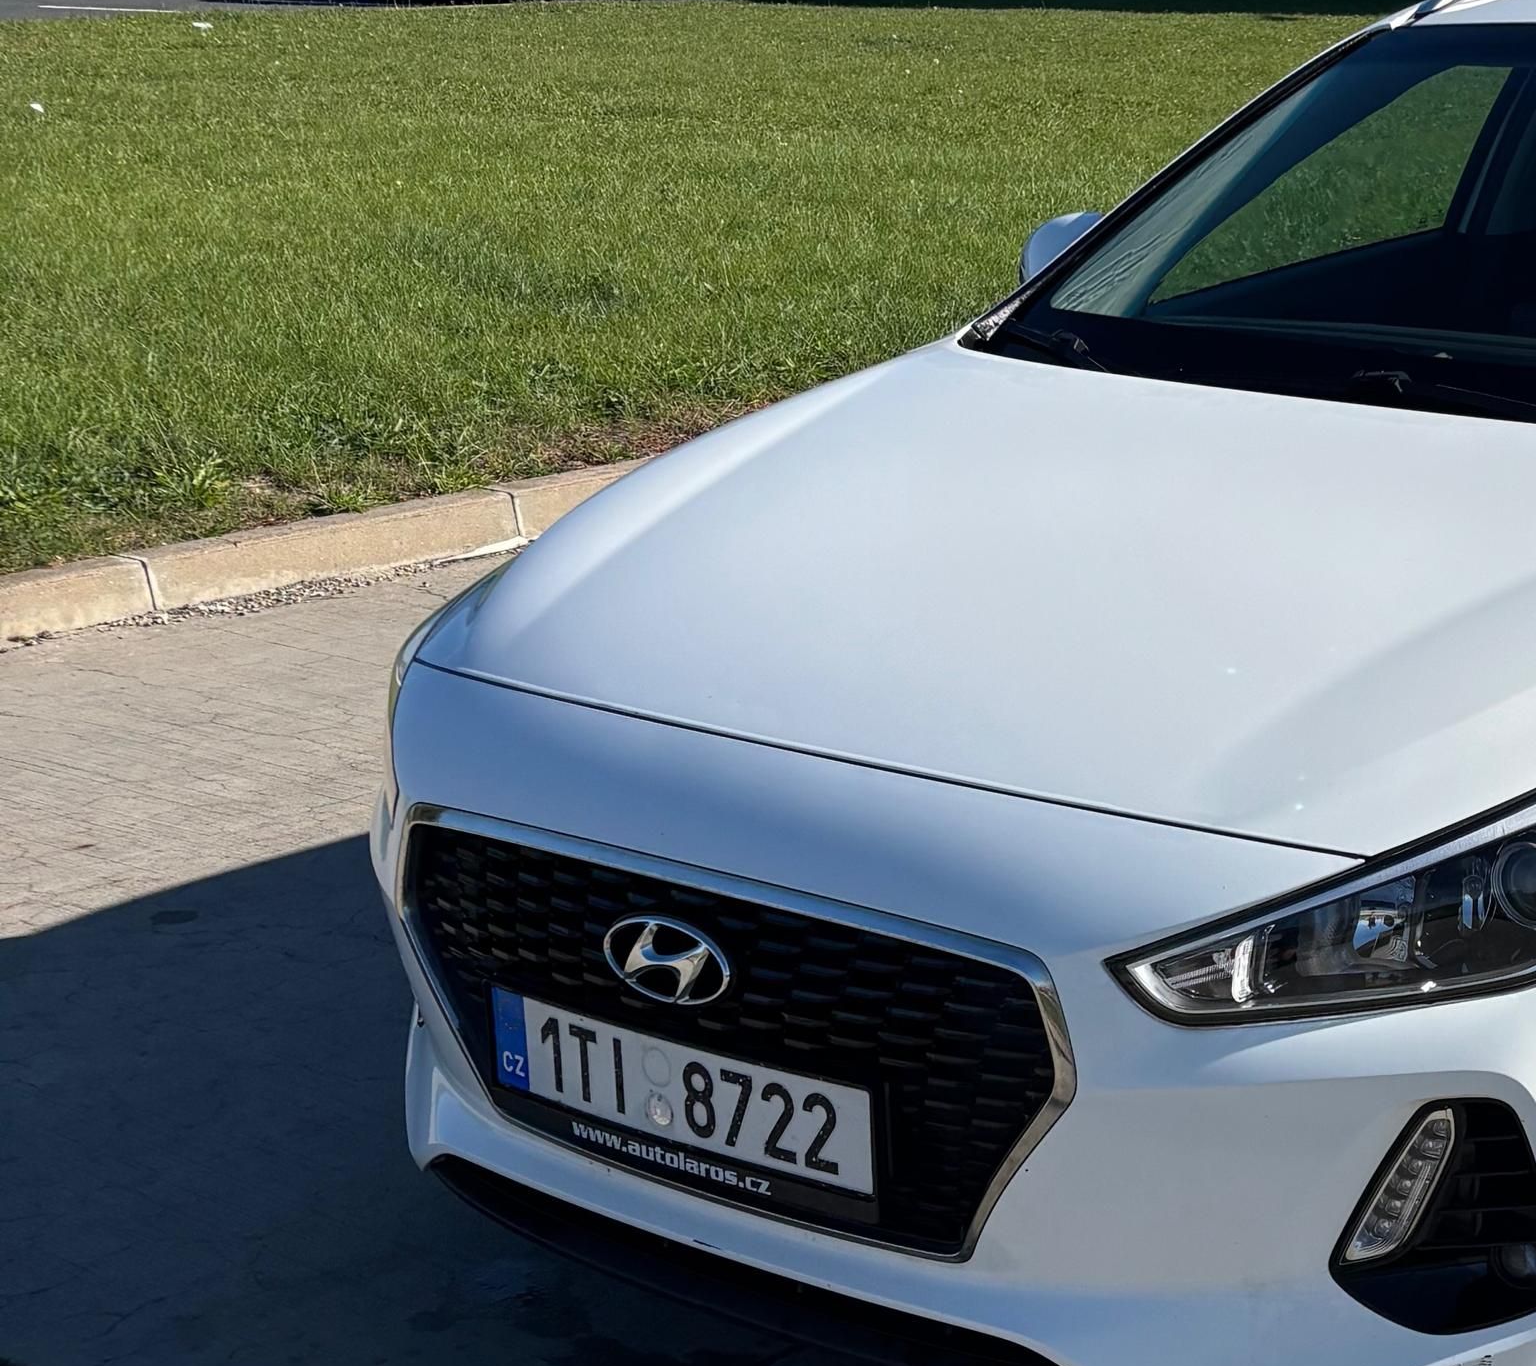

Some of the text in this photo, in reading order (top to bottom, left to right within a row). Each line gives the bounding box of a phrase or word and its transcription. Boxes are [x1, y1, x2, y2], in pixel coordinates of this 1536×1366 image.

[503, 1051, 526, 1077] CZ
[541, 1017, 839, 1176] 1TI 8722
[571, 1121, 772, 1196] www.autolaros.cz
